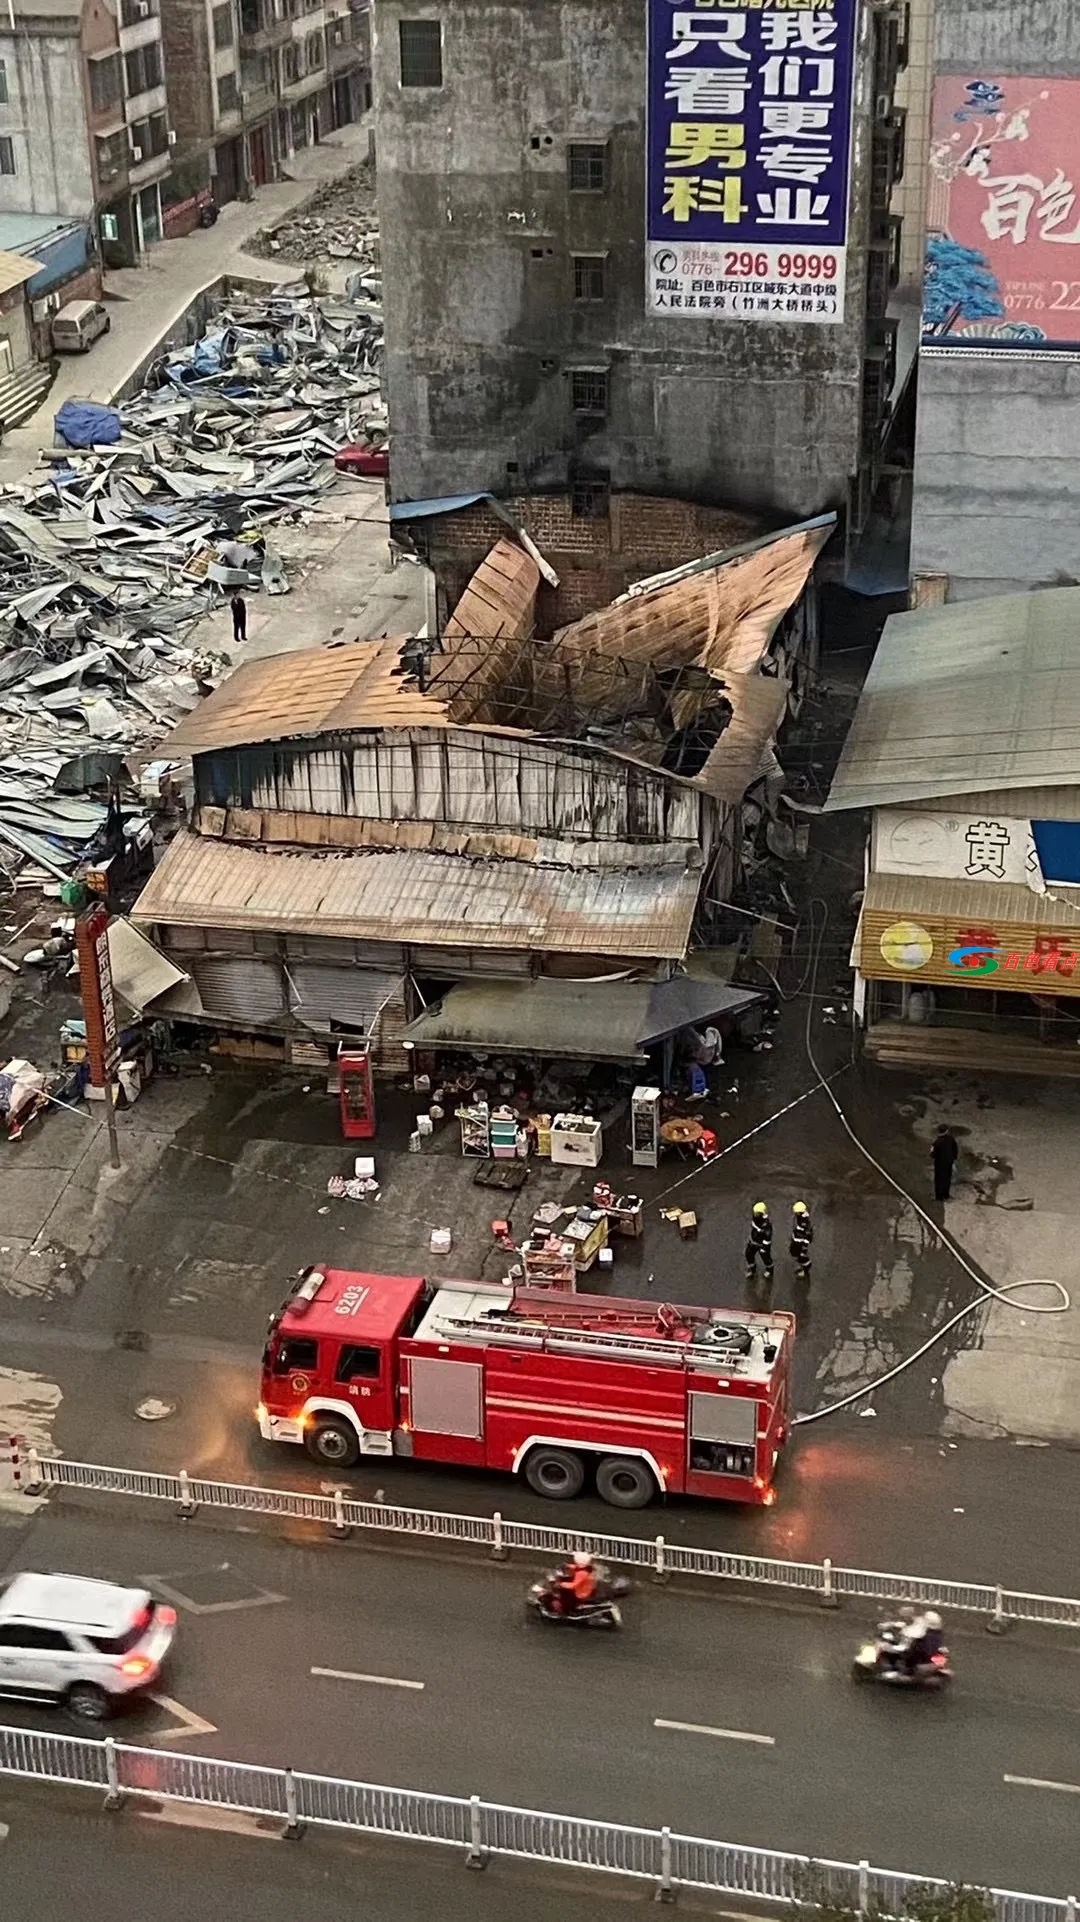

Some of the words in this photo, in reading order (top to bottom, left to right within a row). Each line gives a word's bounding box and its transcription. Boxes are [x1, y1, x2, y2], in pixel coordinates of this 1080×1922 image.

[662, 12, 752, 223] 只看男科
[755, 11, 838, 225] 我们更专业
[977, 168, 1080, 245] 百色
[724, 251, 768, 277] 296
[778, 253, 837, 279] 9999
[1004, 294, 1045, 309] 0776
[334, 1285, 365, 1315] 6203
